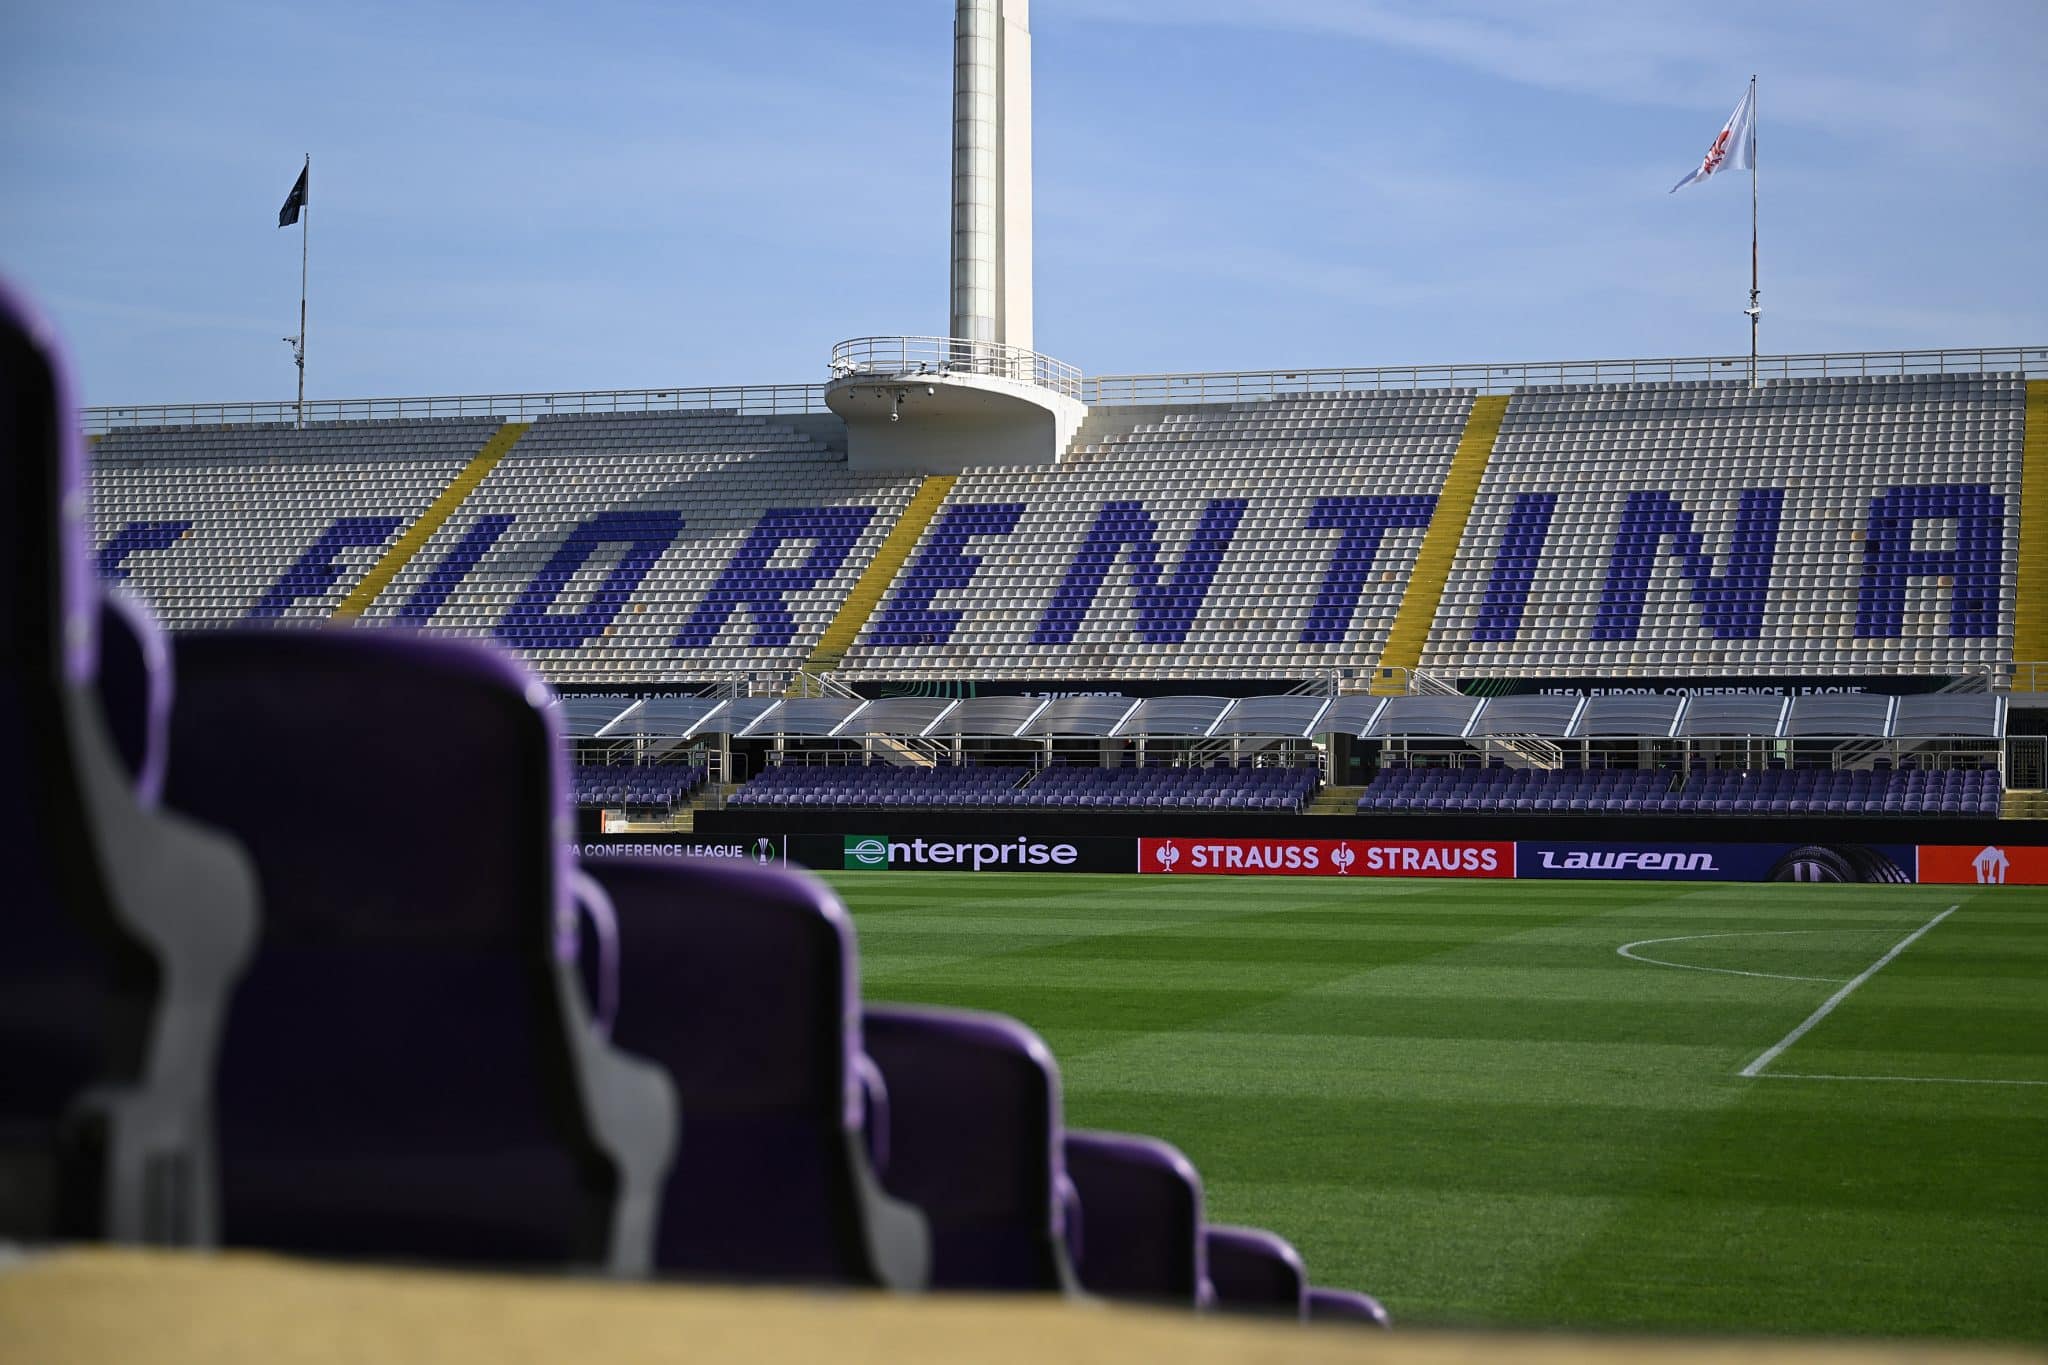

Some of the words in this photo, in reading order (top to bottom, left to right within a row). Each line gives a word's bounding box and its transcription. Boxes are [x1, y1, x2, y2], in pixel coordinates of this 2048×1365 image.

[230, 484, 2004, 647] FIORENTINA
[584, 843, 682, 858] CONFERENCE
[686, 844, 743, 858] LEAGUE
[845, 836, 1078, 871] enterprise
[1191, 845, 1319, 869] STRAUSS
[1366, 846, 1498, 871] STRAUSS
[1537, 851, 1719, 870] Laufenn
